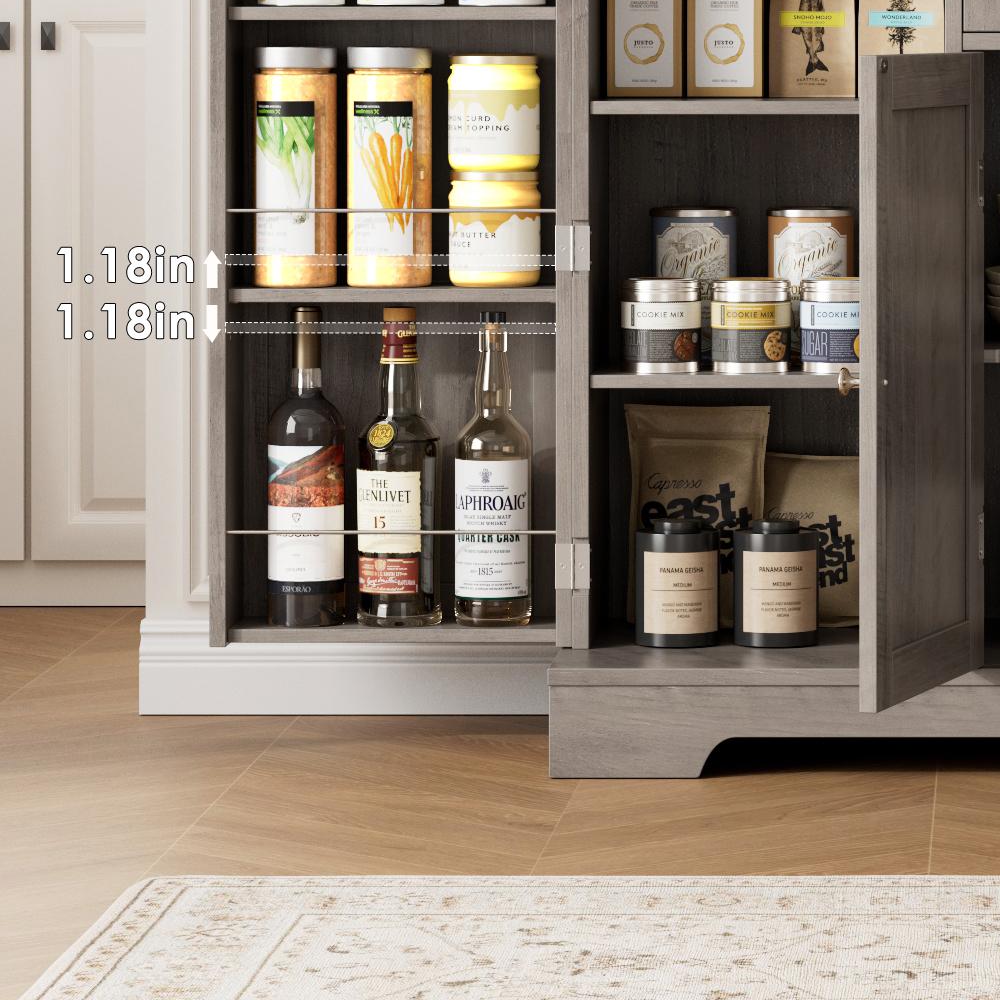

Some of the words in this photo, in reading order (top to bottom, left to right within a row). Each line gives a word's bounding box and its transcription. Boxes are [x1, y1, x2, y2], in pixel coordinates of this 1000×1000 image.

[461, 231, 496, 239] BUTTER
[660, 237, 719, 278] Organic
[778, 237, 838, 280] Organic
[726, 311, 758, 319] COOKIE
[760, 311, 774, 319] MIX
[371, 479, 388, 489] THE
[641, 482, 736, 529] east
[374, 516, 386, 529] 15
[477, 567, 494, 576] 1815
